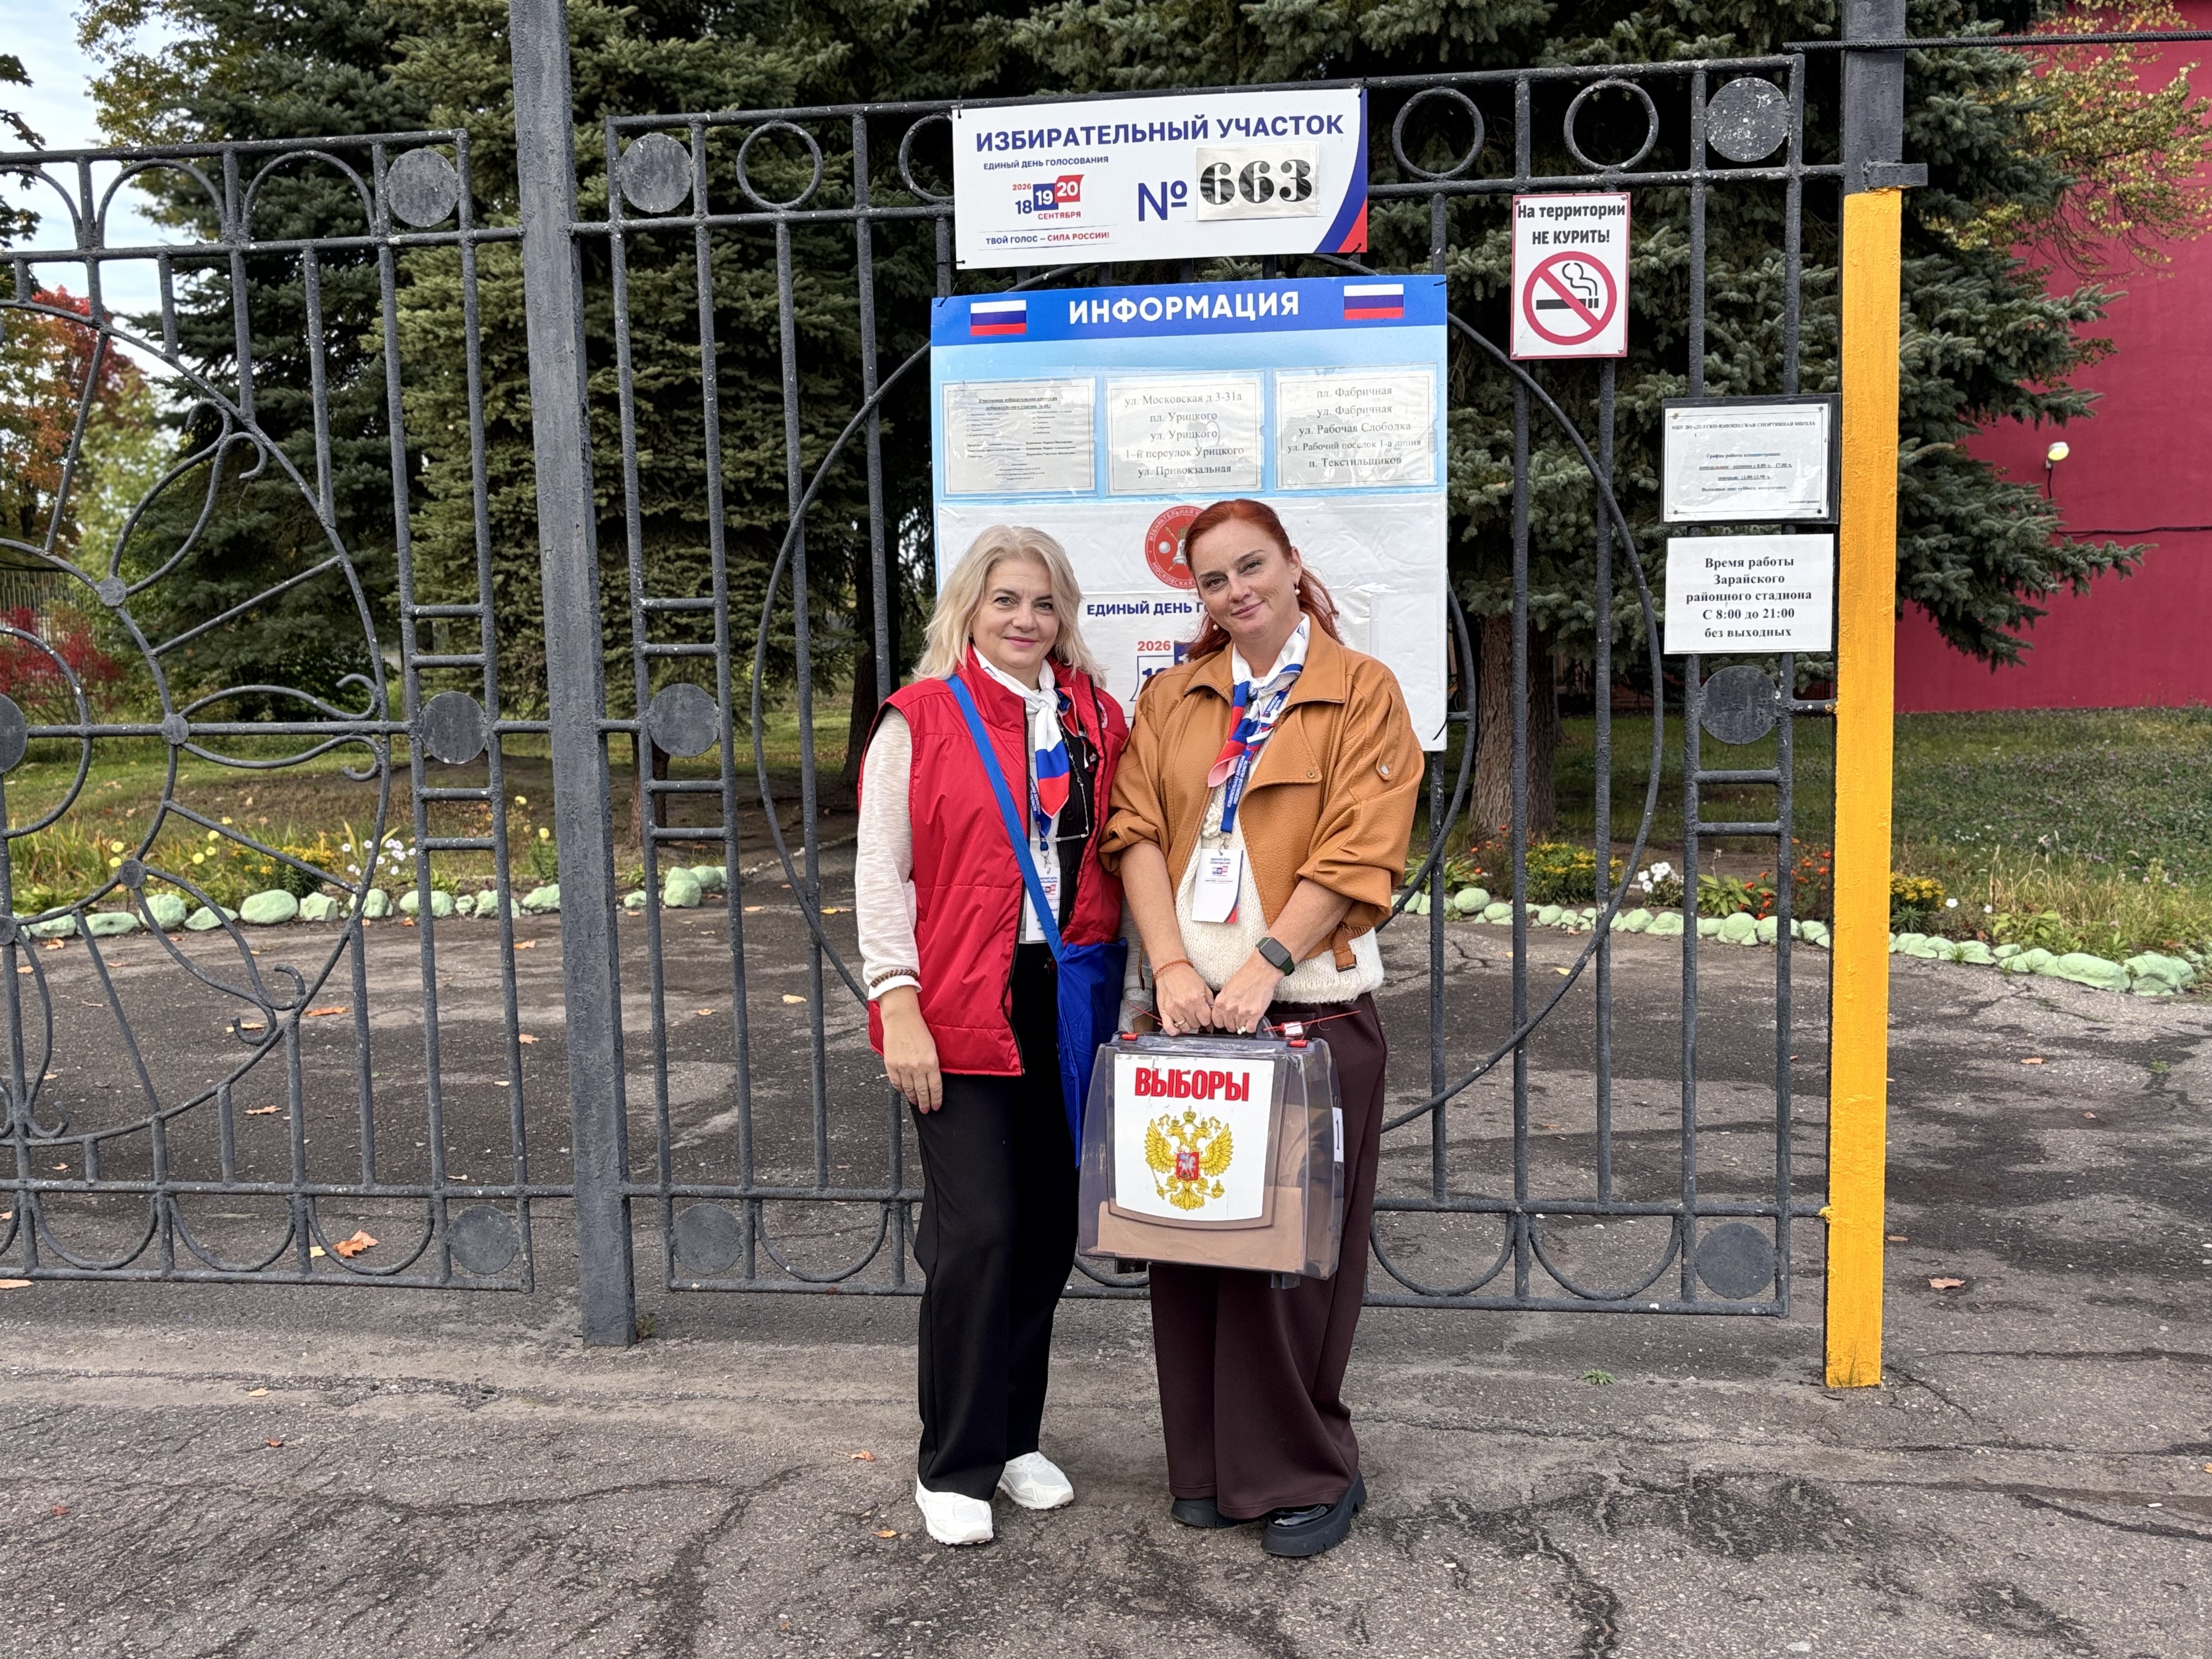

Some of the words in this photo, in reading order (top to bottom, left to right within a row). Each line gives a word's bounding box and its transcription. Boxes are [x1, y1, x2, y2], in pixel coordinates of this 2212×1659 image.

[977, 115, 1208, 152] ИЗБИРАТЕЛЬНЫЙ
[1217, 114, 1344, 138] УЧАСТОК
[984, 160, 1019, 171] ЕДИНЫЙ
[1021, 160, 1043, 168] ДЕНЬ
[1046, 156, 1109, 166] ГОЛОСОВАНИЯ
[1057, 182, 1078, 197] 20
[1138, 180, 1187, 222] №
[1200, 159, 1312, 205] 663
[1035, 190, 1053, 205] 19
[1015, 200, 1032, 215] 18
[1517, 205, 1535, 218] На
[1539, 205, 1625, 221] территории
[1038, 211, 1081, 219] СЕНТЯБРЯ
[986, 236, 1008, 245] ТВОЙ
[1010, 235, 1038, 244] ГОЛОС
[1073, 232, 1109, 240] РОССИИ!
[1532, 231, 1549, 245] НЕ
[1553, 229, 1610, 244] КУРИТЬ!
[1069, 291, 1300, 325] ИНФОРМАЦИЯ
[1317, 390, 1332, 398] пл.
[1335, 387, 1392, 398] Фабричная
[1125, 398, 1139, 408] ул.
[1142, 394, 1203, 405] Московская
[1168, 413, 1217, 424] Урицкого
[1317, 408, 1332, 418] ул.
[1335, 405, 1392, 416] Фабричная
[1150, 432, 1165, 443] ул.
[1168, 430, 1217, 440] Урицкого
[1299, 427, 1314, 437] ул.
[1317, 424, 1358, 435] Рабочая
[1361, 422, 1411, 433] Слободка
[1146, 449, 1192, 460] переулок
[1195, 447, 1244, 459] Урицкого
[1288, 445, 1300, 453] ул.
[1302, 442, 1339, 452] Рабочий
[1321, 457, 1402, 467] Текстильщиков
[1138, 469, 1153, 478] ул.
[1155, 466, 1232, 478] Привокзальная
[1148, 508, 1194, 541] ИЗБИРАТЕЛЬНАЯ
[1705, 558, 1744, 570] Время
[1748, 556, 1794, 569] работы
[1152, 561, 1193, 586] МОСКОВСКАЯ
[1713, 574, 1785, 586] Зарайского
[1686, 592, 1751, 605] районного
[1756, 591, 1812, 601] стадиона
[1087, 601, 1150, 617] ЕДИНЫЙ
[1153, 603, 1192, 615] ДЕНЬ
[1703, 610, 1712, 620] С
[1716, 609, 1741, 620] 8:00
[1763, 608, 1795, 619] 21:00
[1705, 628, 1723, 637] без
[1727, 629, 1792, 637] выходных
[1137, 641, 1171, 651] 2026
[1135, 1067, 1250, 1102] ВЫБОРЫ
